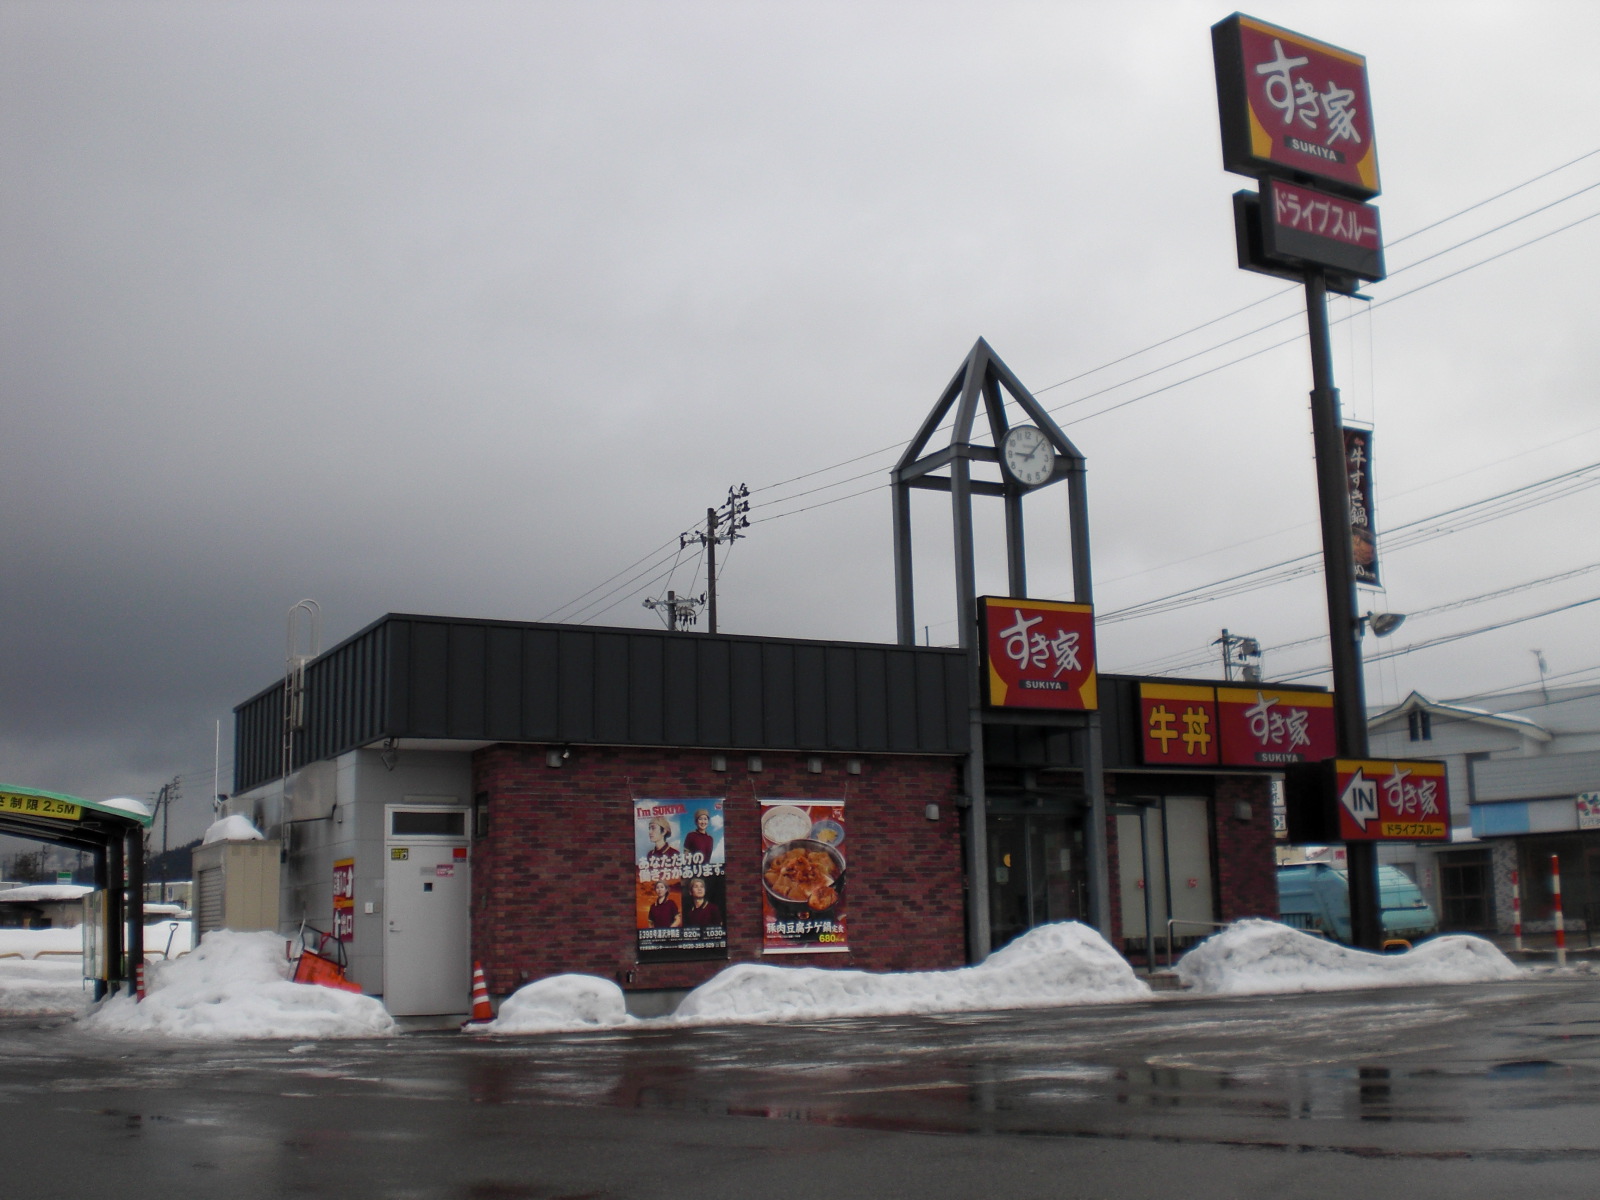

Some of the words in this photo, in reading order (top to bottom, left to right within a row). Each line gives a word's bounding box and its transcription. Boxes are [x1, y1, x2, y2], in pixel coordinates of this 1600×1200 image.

[1256, 38, 1362, 146] すき家
[1291, 138, 1337, 161] SUKIYA
[1274, 187, 1377, 242] ドライブスルー
[999, 609, 1082, 678] すき家
[1025, 680, 1062, 690] SUKIYA
[1149, 704, 1212, 756] 牛丼
[1245, 691, 1311, 752] すき家
[1261, 753, 1298, 763] SUKIYA
[1352, 788, 1375, 812] IN
[1383, 763, 1439, 821] すき家
[636, 807, 651, 818] I'm
[1387, 824, 1443, 835] ドライブスルー
[638, 852, 705, 870] あなただけの
[639, 863, 725, 882] 働き方があります。
